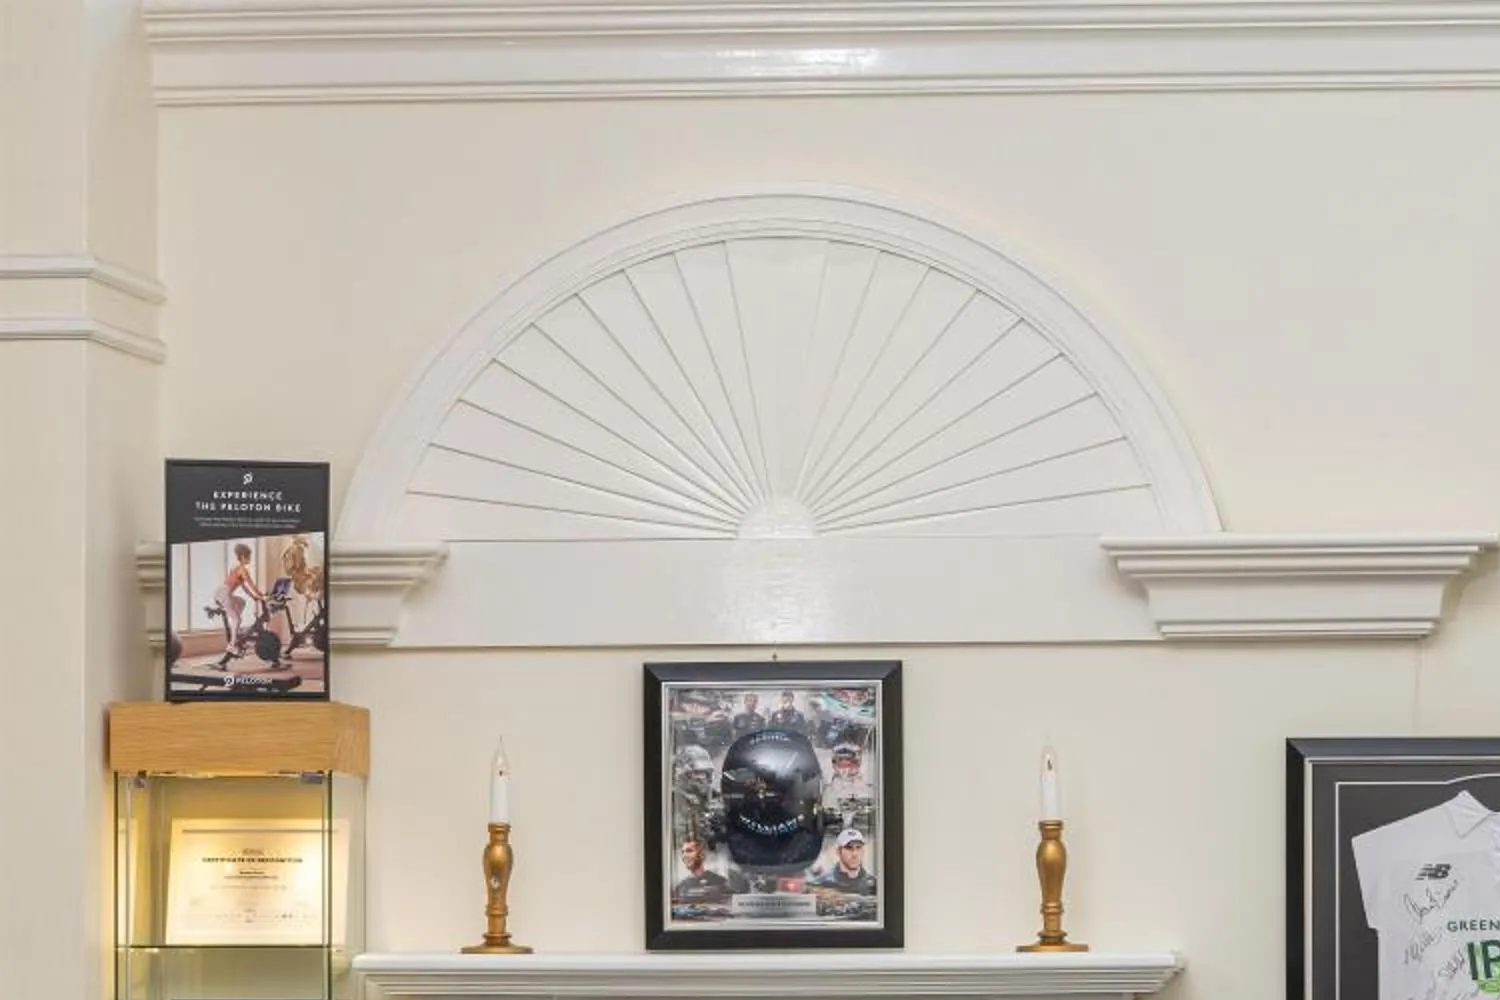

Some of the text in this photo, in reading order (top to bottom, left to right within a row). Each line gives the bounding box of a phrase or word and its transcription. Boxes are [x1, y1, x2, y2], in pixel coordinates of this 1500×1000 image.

[195, 501, 301, 512] THE PELOTON BIKE
